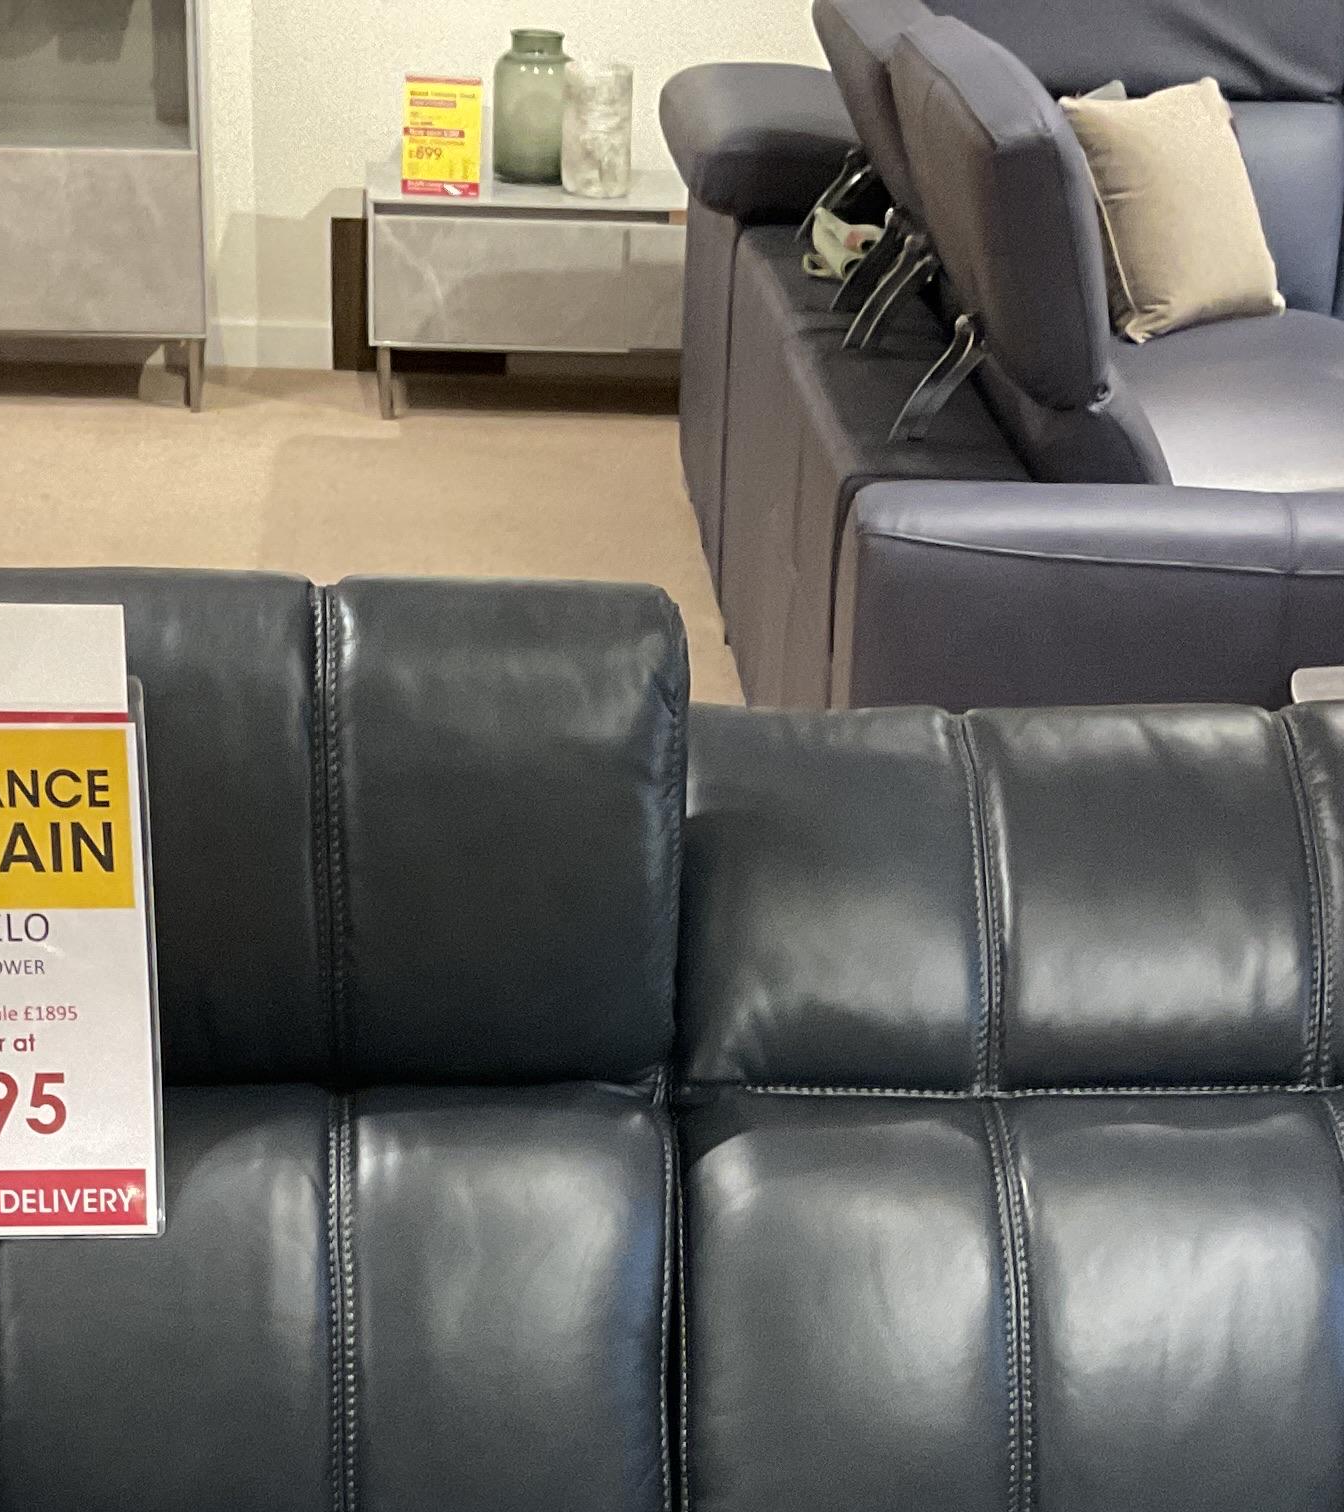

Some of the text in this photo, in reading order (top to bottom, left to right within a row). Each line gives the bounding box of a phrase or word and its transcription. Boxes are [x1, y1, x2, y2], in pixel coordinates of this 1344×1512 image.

[23, 1005, 78, 1022] £1895
[12, 1035, 36, 1052] at
[0, 1188, 135, 1215] DELIVERY
